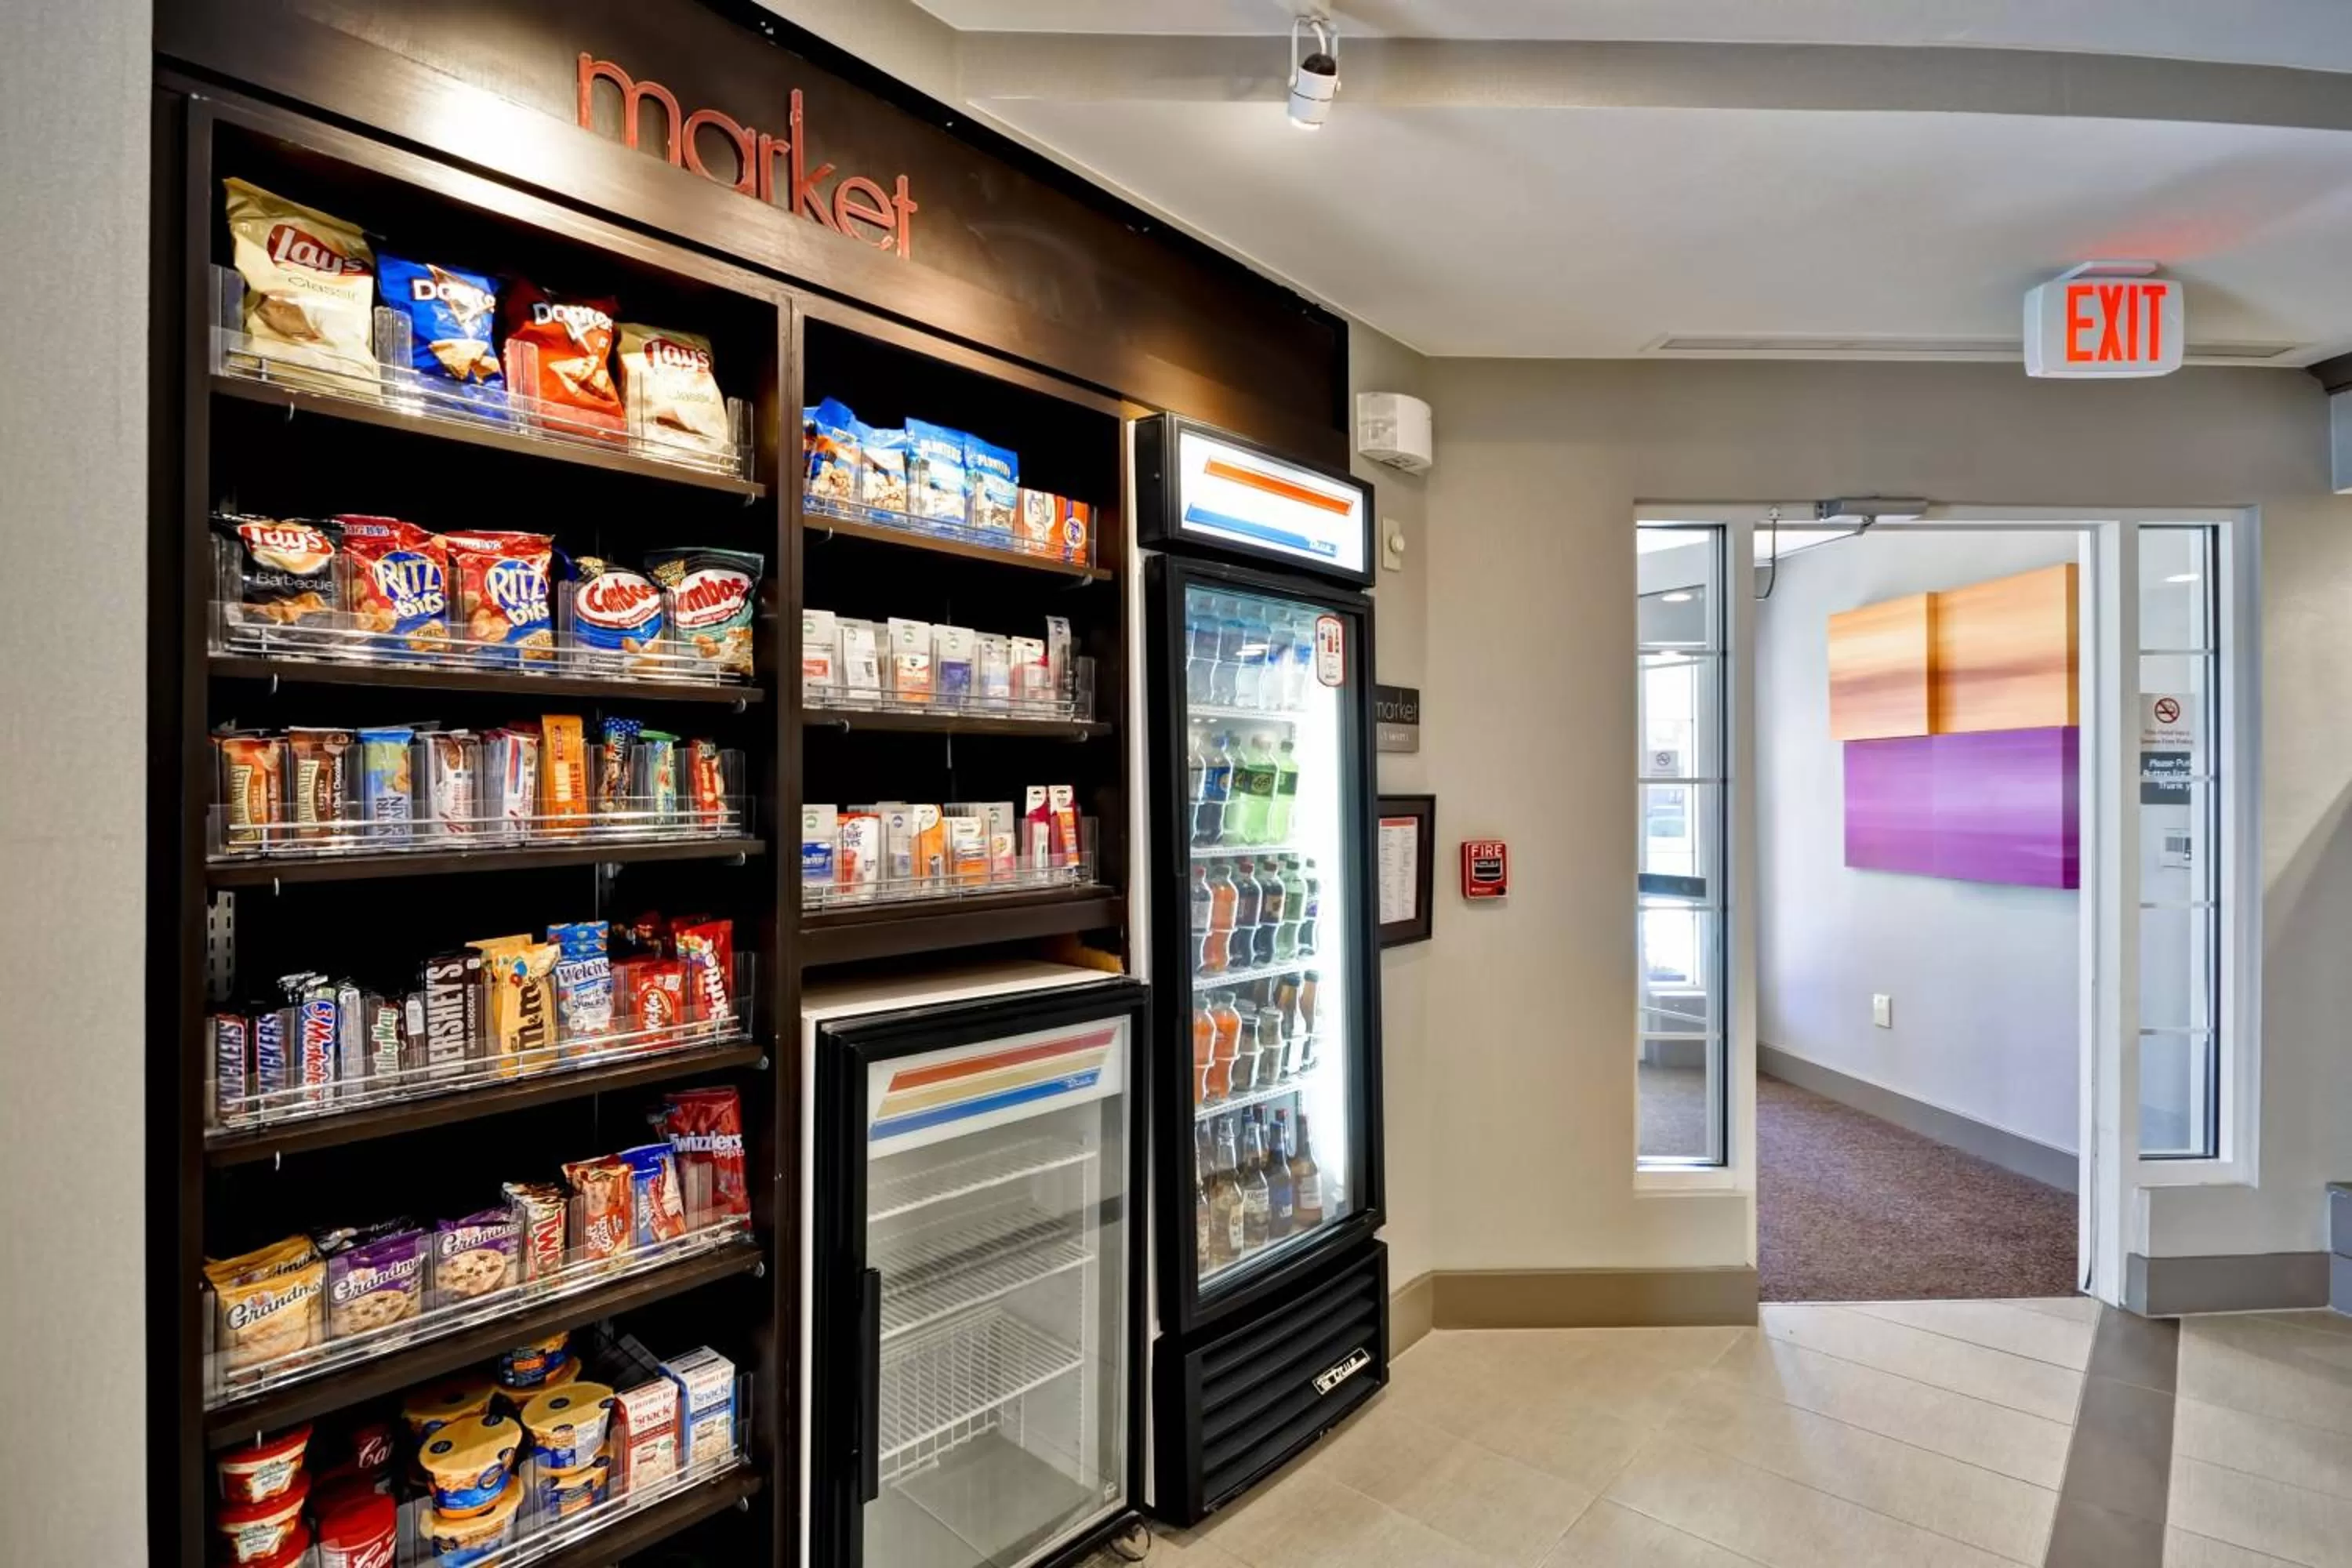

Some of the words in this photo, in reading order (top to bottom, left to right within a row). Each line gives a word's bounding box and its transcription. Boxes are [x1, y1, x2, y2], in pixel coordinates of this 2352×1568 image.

[577, 52, 917, 261] market
[2065, 284, 2168, 363] EXIT
[256, 571, 334, 592] Barbecue
[375, 558, 444, 596] RITZ
[677, 576, 745, 614] ombos
[612, 731, 627, 762] KIND
[376, 797, 391, 837] NTRI
[390, 796, 405, 837] GAIN
[1471, 844, 1503, 858] FIRE
[558, 960, 610, 983] Welch's
[466, 982, 476, 1030] CHOCOLATE
[669, 1130, 743, 1153] Twizzlers
[533, 1210, 563, 1272] TWI
[633, 1403, 672, 1426] Snack
